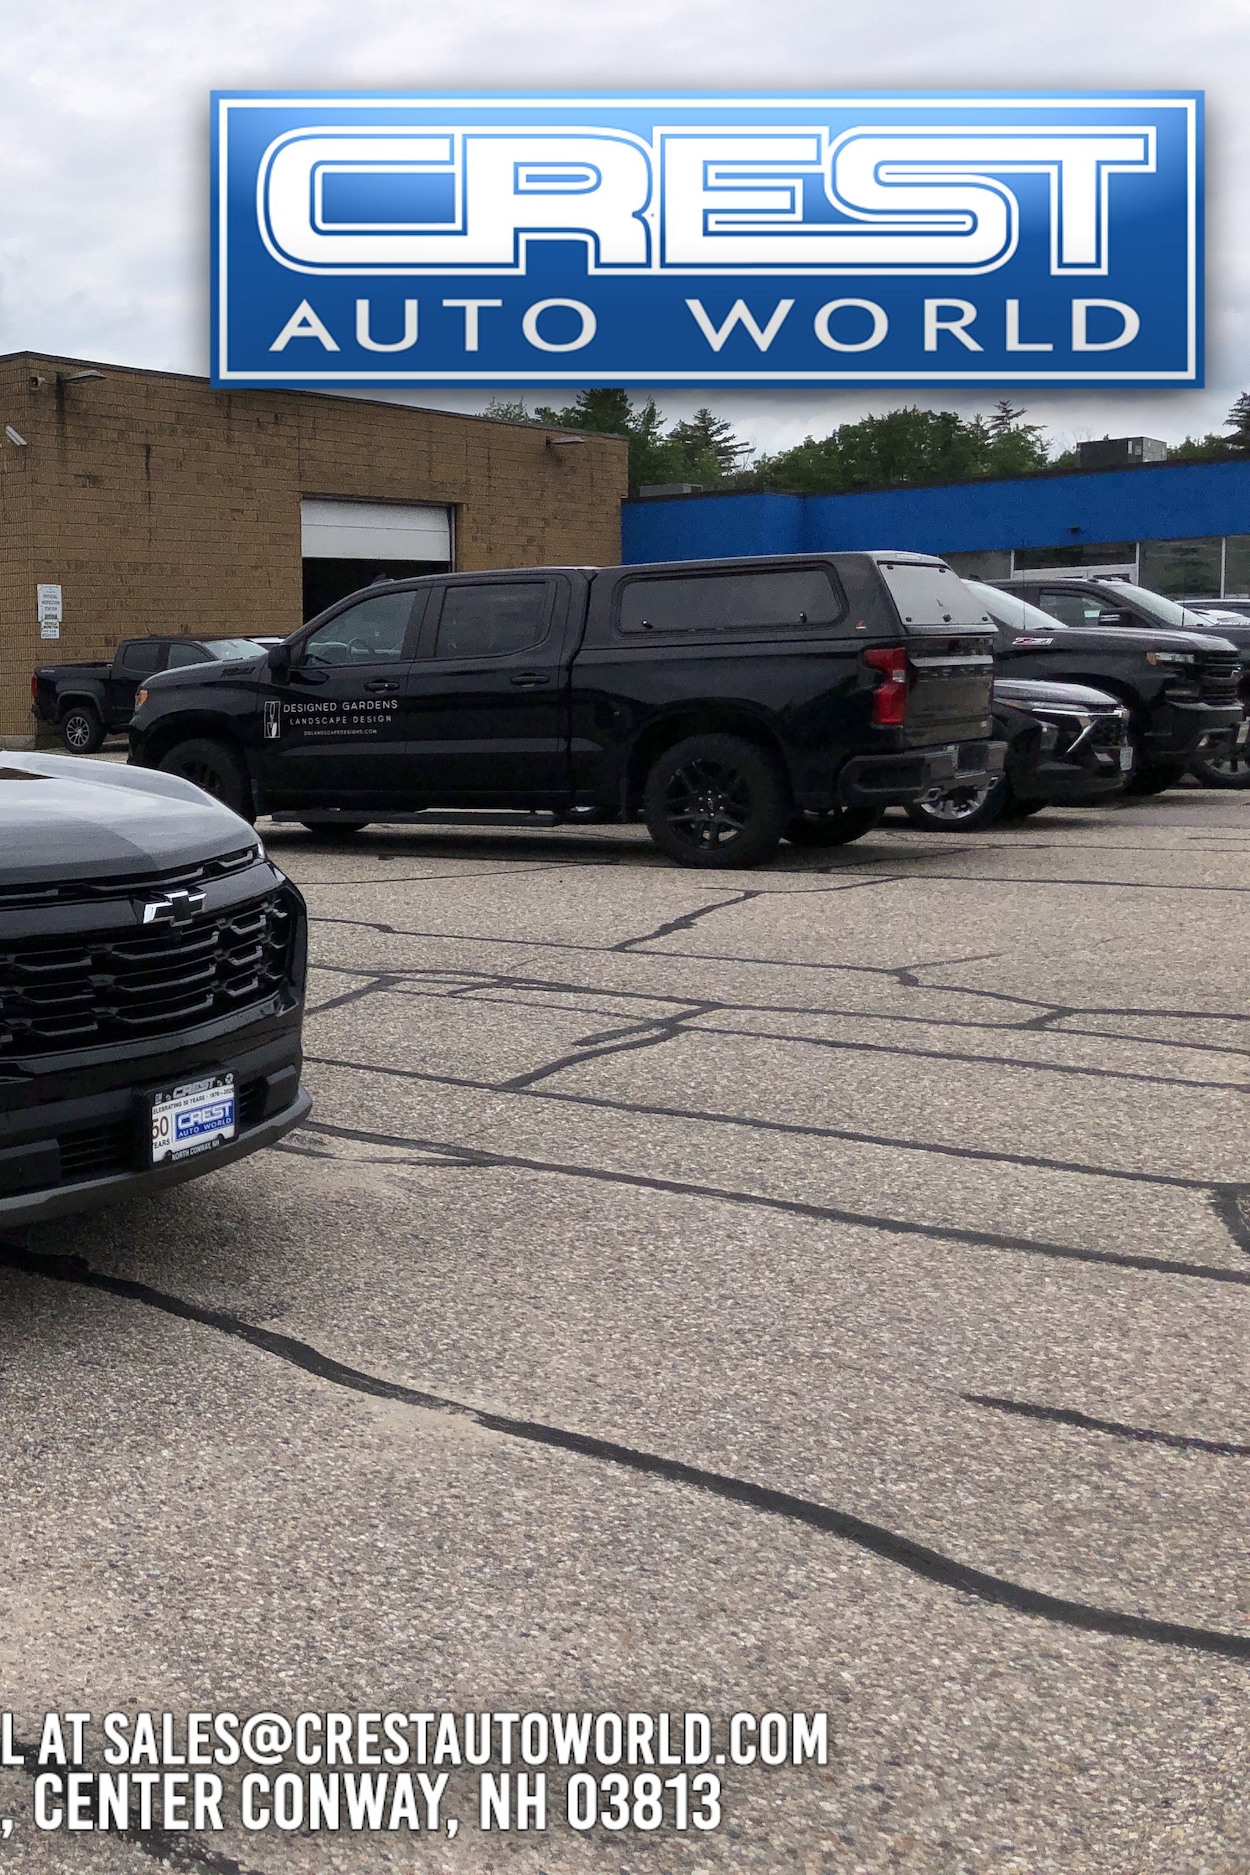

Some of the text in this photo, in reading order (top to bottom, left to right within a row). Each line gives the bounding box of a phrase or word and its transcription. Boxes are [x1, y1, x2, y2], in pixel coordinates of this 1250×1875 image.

[283, 699, 398, 713] DESIGNED GARDENS
[289, 714, 392, 726] LANDSCAPE DESIGN
[173, 1077, 216, 1098] CREST
[153, 1102, 182, 1115] ELEBRATING
[190, 1095, 205, 1104] YEARS
[177, 1101, 232, 1130] CREST
[178, 1117, 232, 1138] AUTO WORLD
[171, 1147, 189, 1160] NORTH
